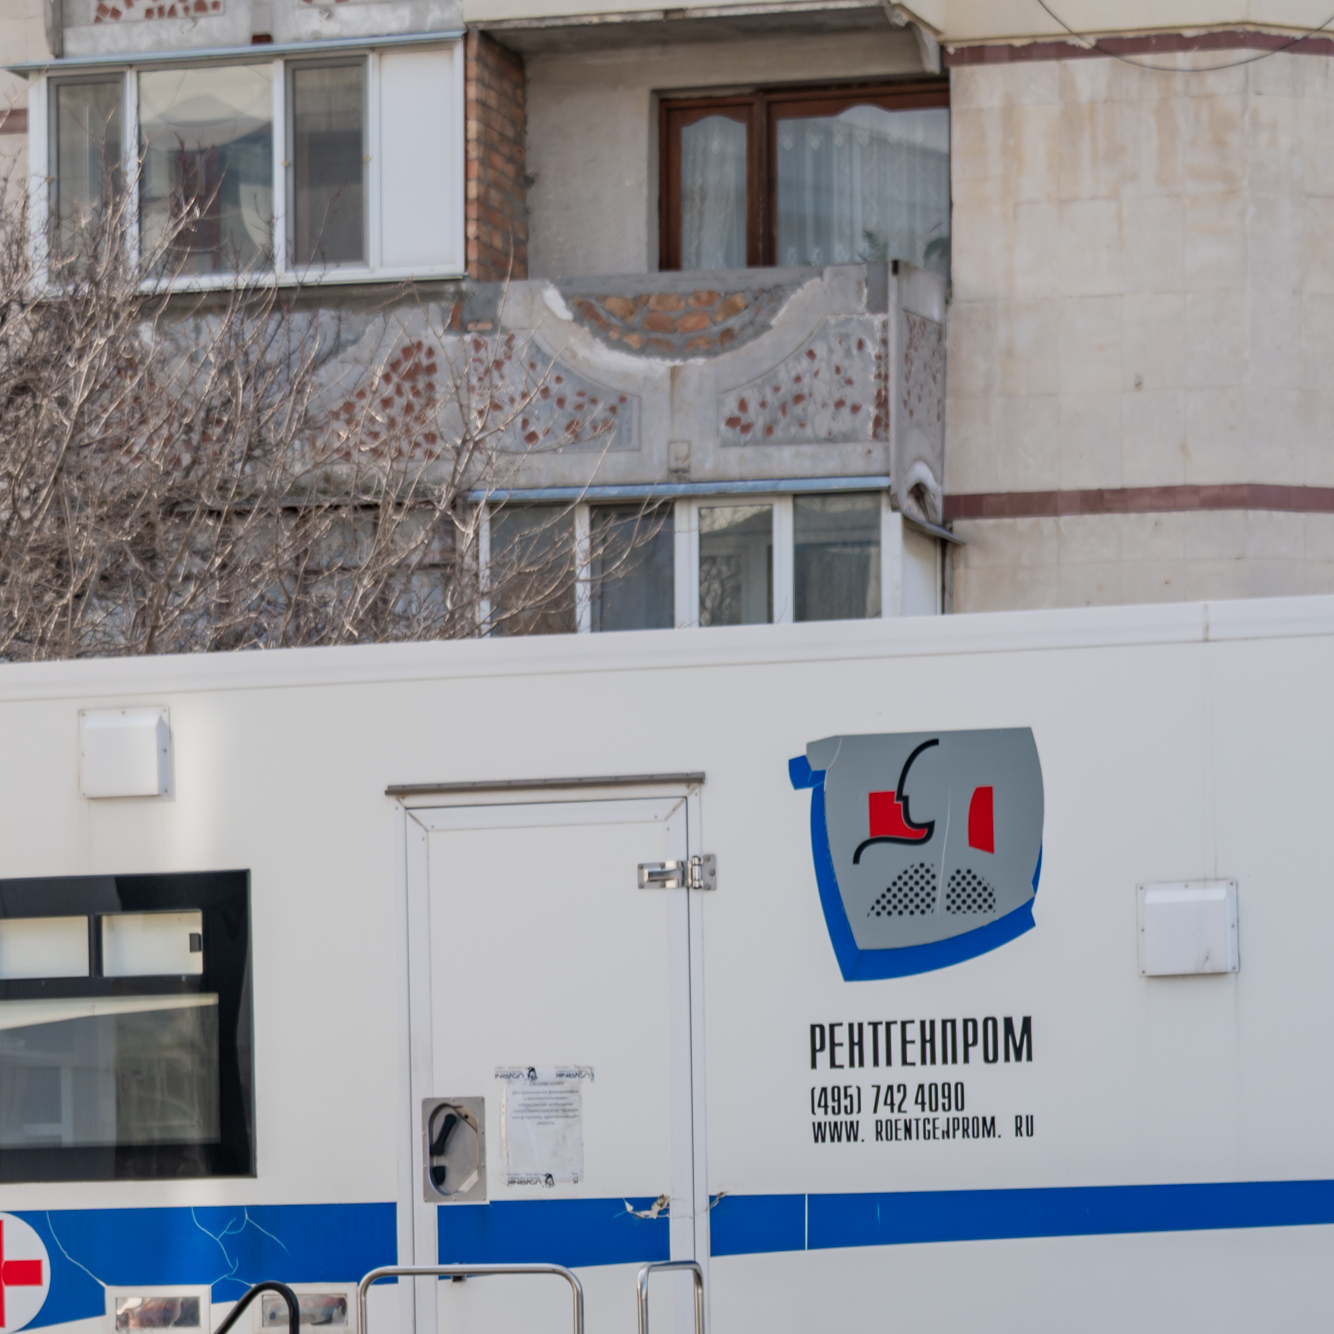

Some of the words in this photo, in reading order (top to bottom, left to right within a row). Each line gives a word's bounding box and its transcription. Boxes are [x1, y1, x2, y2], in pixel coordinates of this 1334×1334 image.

[810, 1016, 1033, 1070] РЕНТГЕНПРОМ
[811, 1084, 862, 1116] (495)
[872, 1083, 907, 1114] 742
[914, 1082, 965, 1112] 4090
